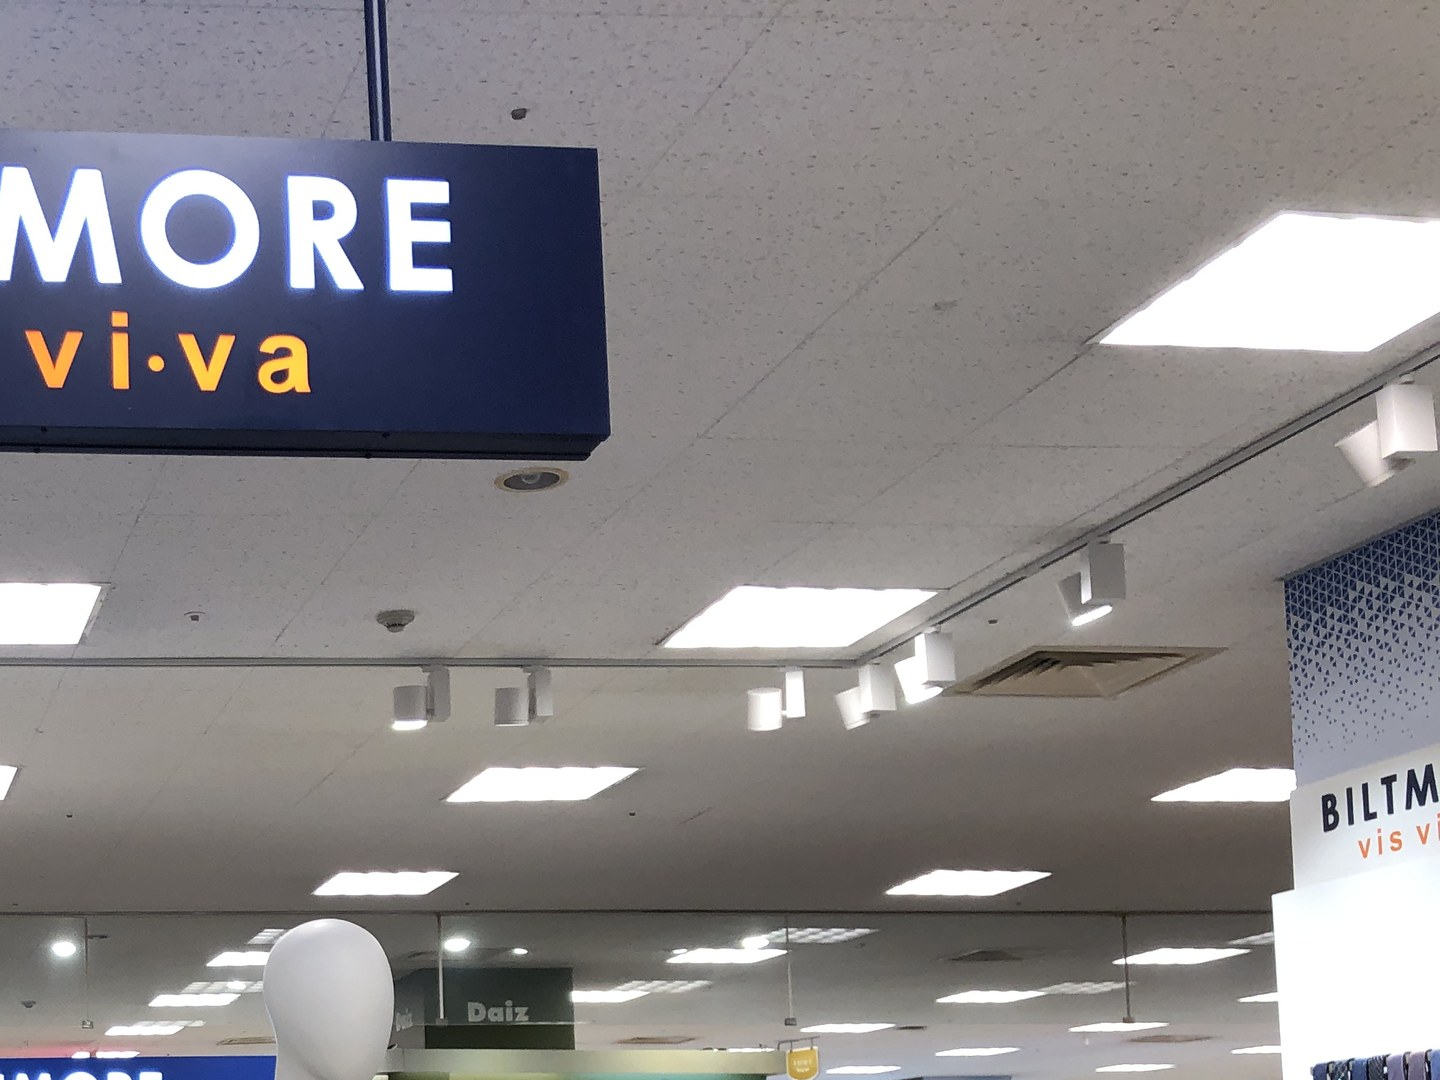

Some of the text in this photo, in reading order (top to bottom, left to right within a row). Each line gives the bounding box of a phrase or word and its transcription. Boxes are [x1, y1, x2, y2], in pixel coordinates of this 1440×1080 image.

[1321, 763, 1440, 833] BILTM
[1358, 828, 1403, 859] vis
[467, 1000, 530, 1023] Daiz
